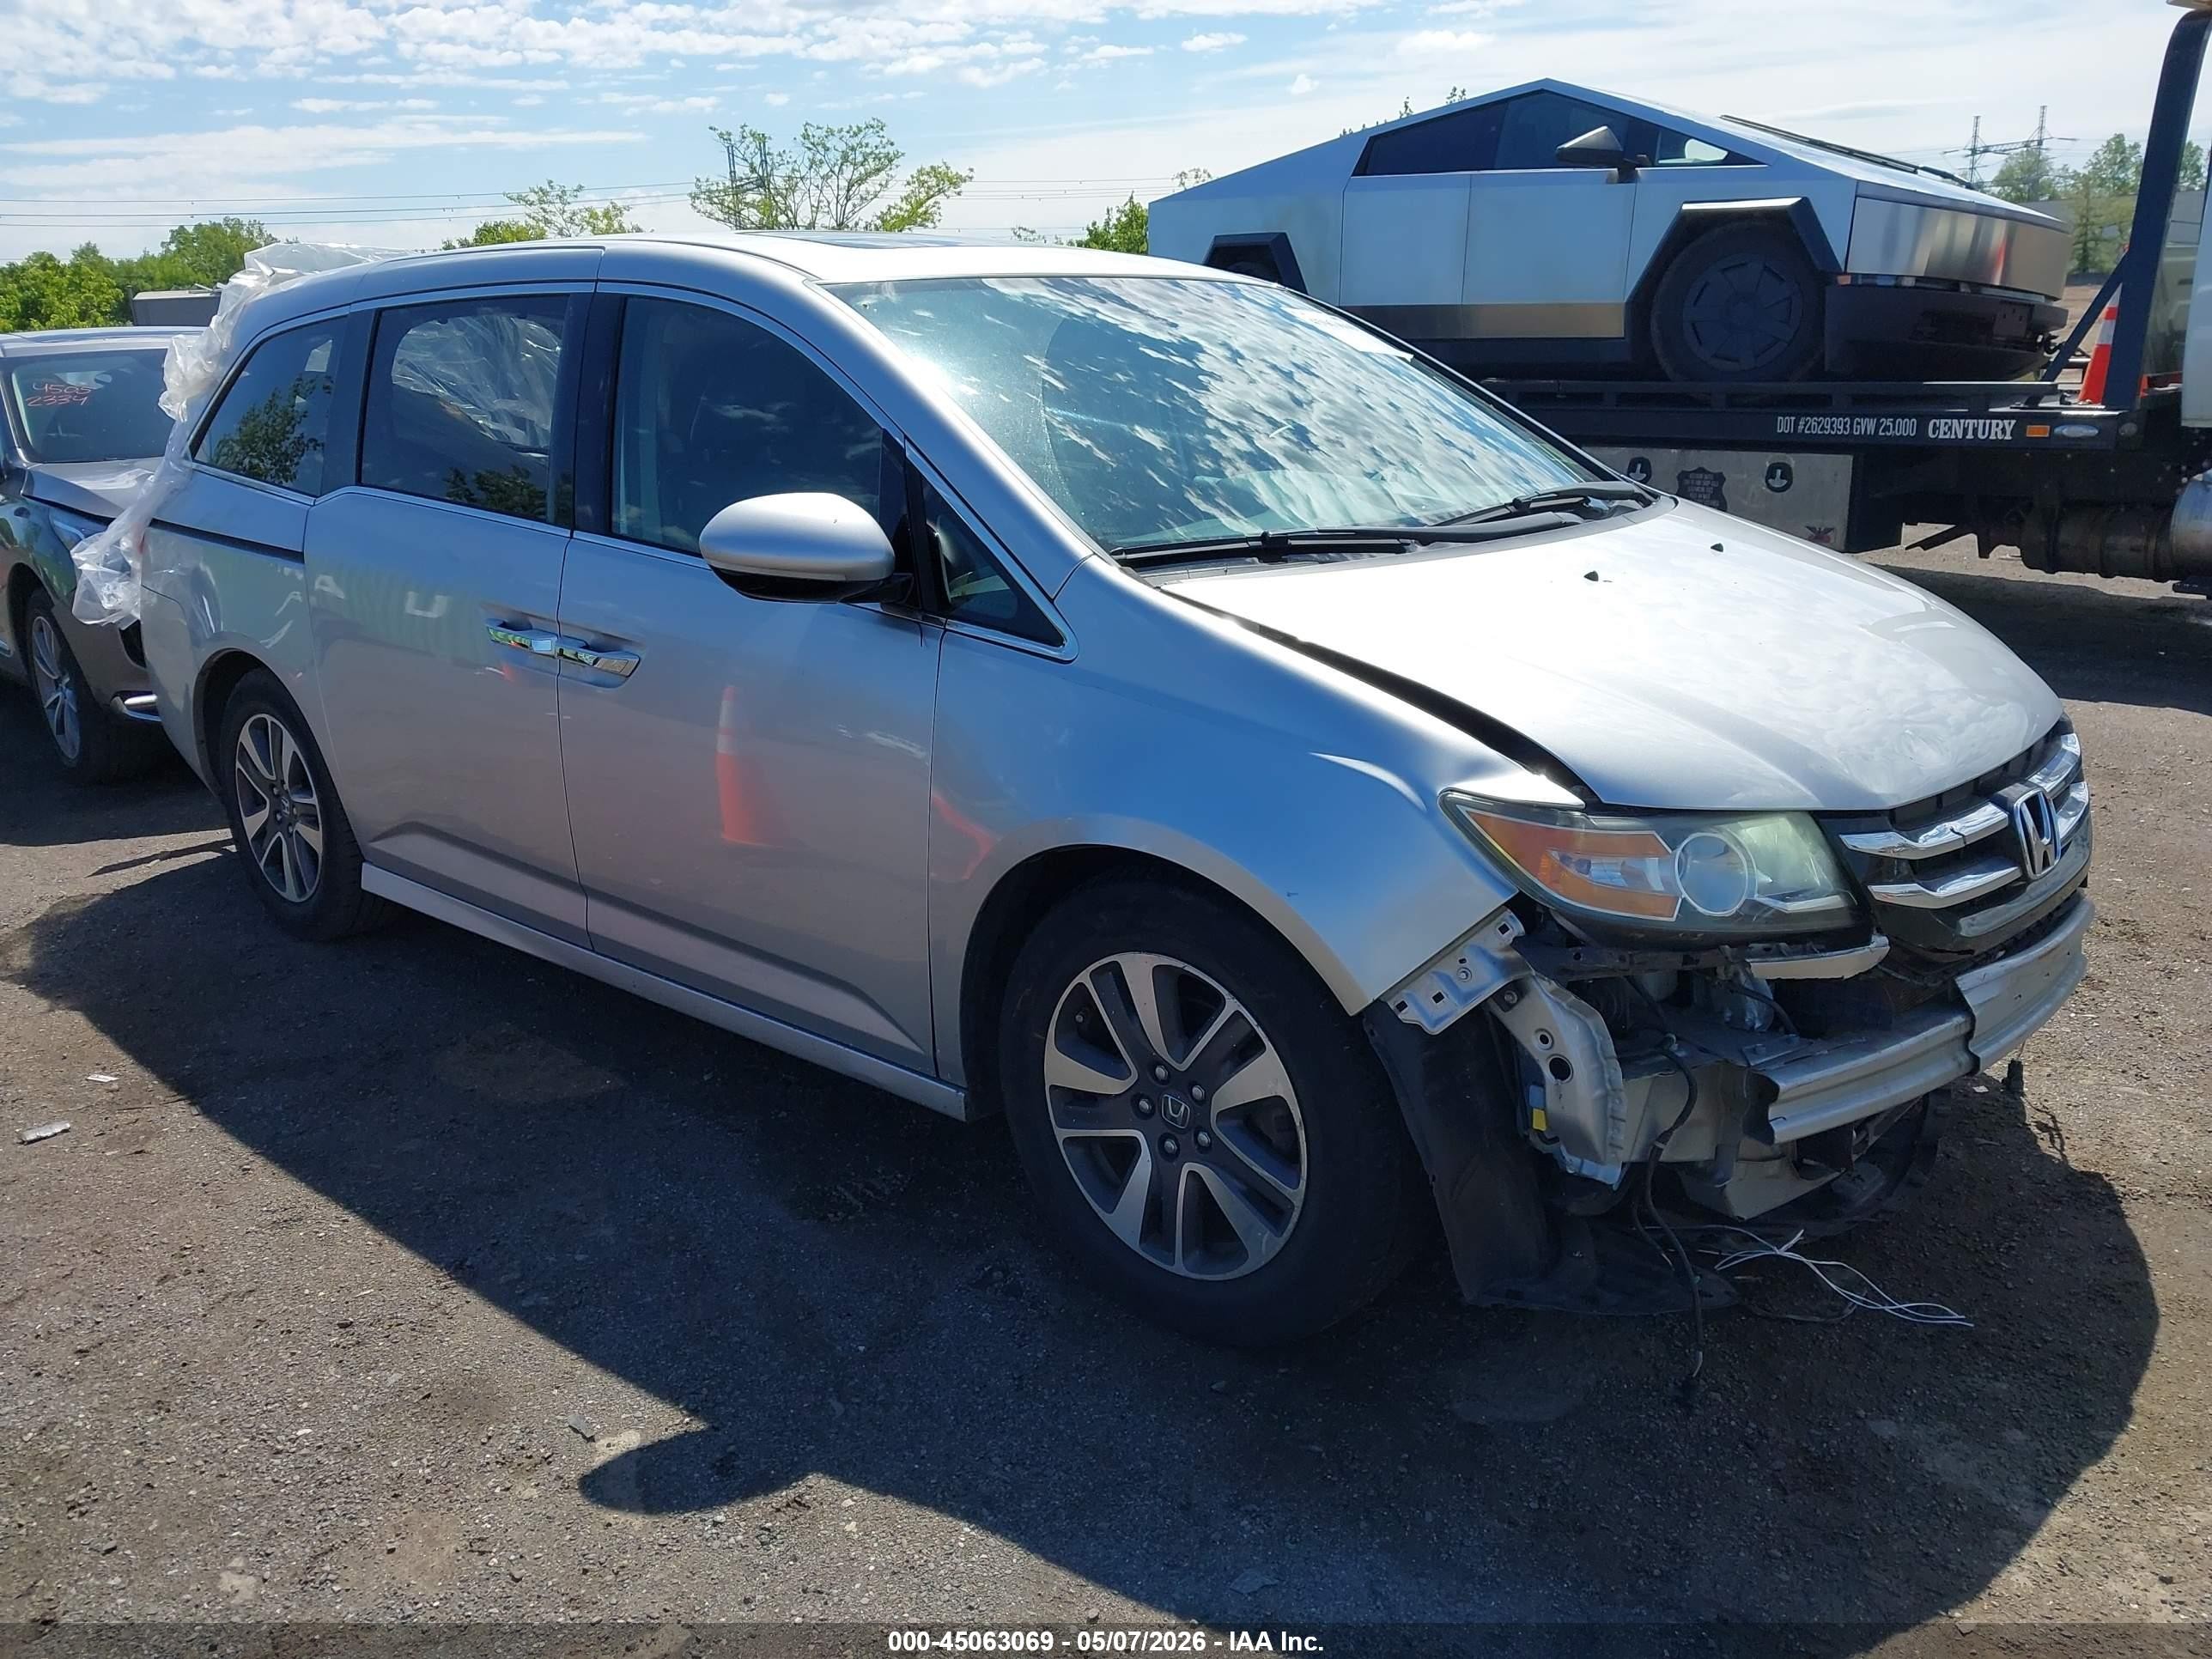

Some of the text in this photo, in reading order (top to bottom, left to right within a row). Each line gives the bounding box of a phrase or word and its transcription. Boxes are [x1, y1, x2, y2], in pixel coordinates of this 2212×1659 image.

[32, 382, 97, 395] 4505
[1777, 416, 1917, 438] DOT #2629393 GVW 25,000
[1928, 418, 2016, 441] CENTURY
